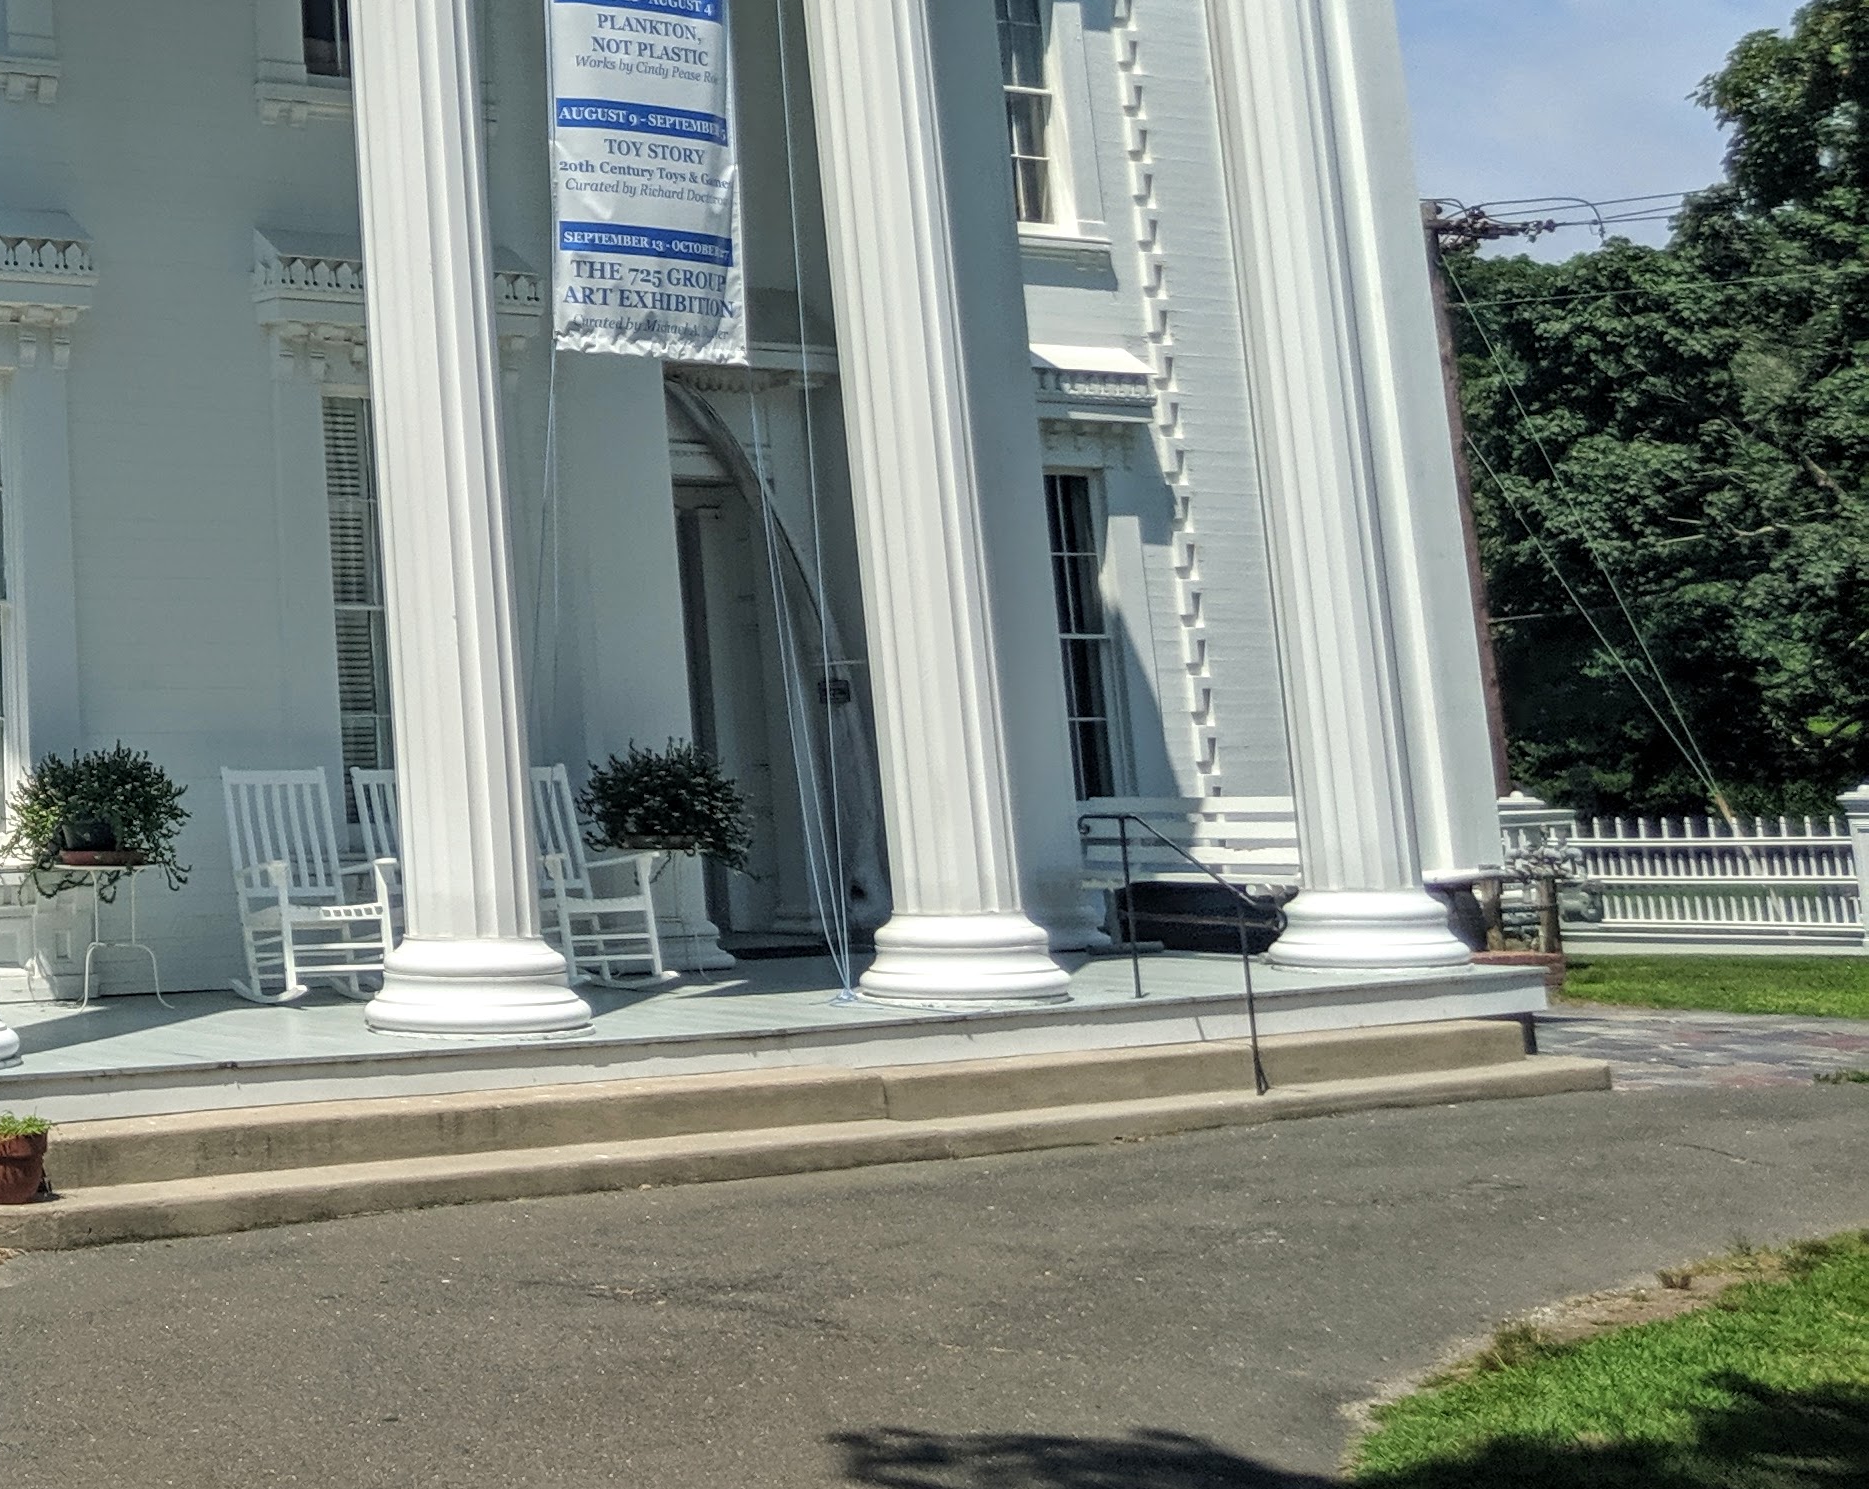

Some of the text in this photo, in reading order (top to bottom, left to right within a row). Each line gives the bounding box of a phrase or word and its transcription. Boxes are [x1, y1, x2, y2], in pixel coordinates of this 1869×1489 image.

[704, 3, 712, 16] 4
[597, 13, 702, 45] PLANKTON,
[591, 36, 708, 67] NOT PLASTIC
[575, 54, 616, 70] Works
[619, 61, 632, 76] by
[636, 62, 668, 79] Cindy
[672, 66, 700, 82] Pease
[559, 106, 627, 123] AUGUST
[629, 115, 637, 127] 9
[604, 138, 705, 165] TOY STORY
[559, 160, 595, 173] 20th
[599, 161, 655, 181] Century
[656, 167, 686, 184] Toys
[689, 173, 698, 184] &
[565, 178, 619, 194] Curated
[623, 183, 637, 197] by
[640, 185, 683, 200] Richard
[563, 231, 649, 248] SEPTEMBER
[652, 240, 663, 252] 13
[570, 259, 726, 293] THE 725 GROUP
[563, 285, 734, 319] ART EXHIBITION
[574, 314, 623, 330] Curated
[626, 316, 642, 332] by
